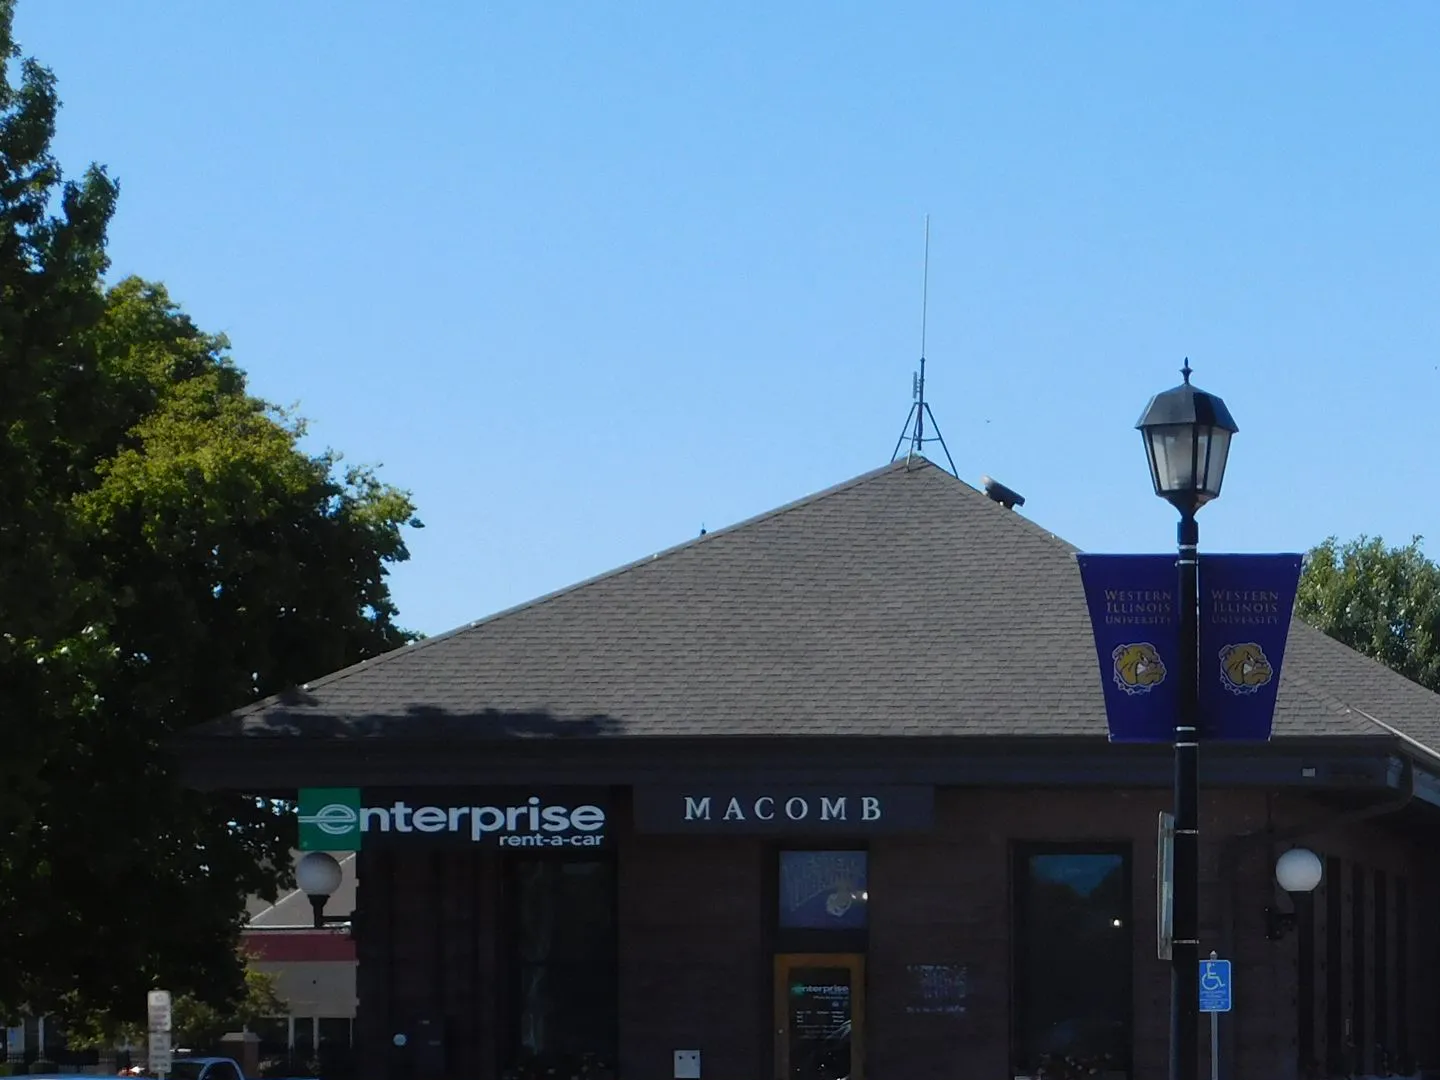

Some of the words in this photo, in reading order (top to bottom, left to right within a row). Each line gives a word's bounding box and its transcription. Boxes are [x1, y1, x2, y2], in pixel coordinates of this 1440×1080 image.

[1104, 589, 1172, 601] WESTERN
[1210, 589, 1279, 601] WESTERN
[1106, 602, 1171, 613] ILLINOIS
[1214, 602, 1278, 613] ILLINOIS
[1105, 615, 1171, 625] UNIVERSITY
[684, 796, 881, 821] MACOMB
[298, 796, 605, 841] enterprise
[499, 833, 604, 846] rent-a-car
